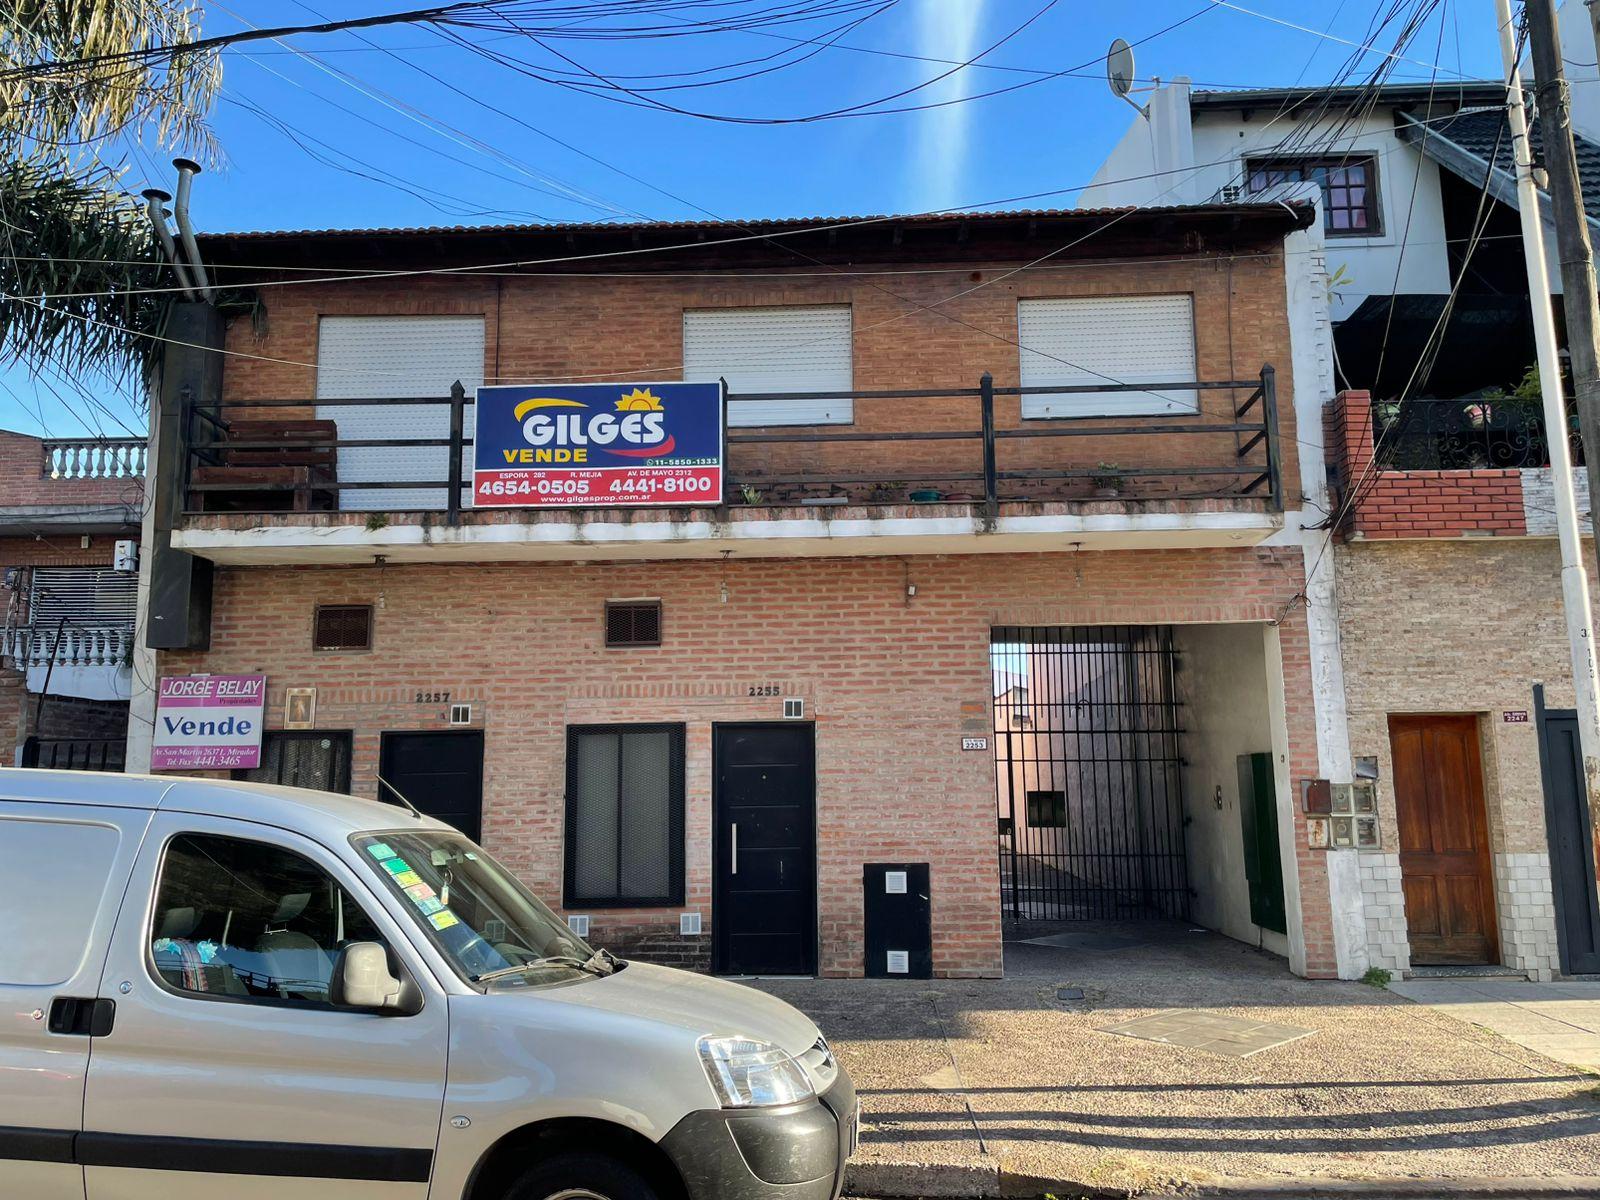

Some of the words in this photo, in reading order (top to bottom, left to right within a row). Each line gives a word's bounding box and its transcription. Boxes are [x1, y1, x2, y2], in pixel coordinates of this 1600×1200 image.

[522, 413, 665, 446] GILGES
[503, 449, 588, 463] VENDE
[479, 480, 590, 495] 4654-0505
[610, 477, 712, 493] 4441-8100
[540, 494, 652, 503] www.gilgesprop.com.ar
[163, 681, 215, 696] JORGE
[216, 680, 262, 695] BELAY
[749, 686, 780, 696] 2255
[416, 692, 450, 703] 2257
[163, 716, 252, 736] Vende
